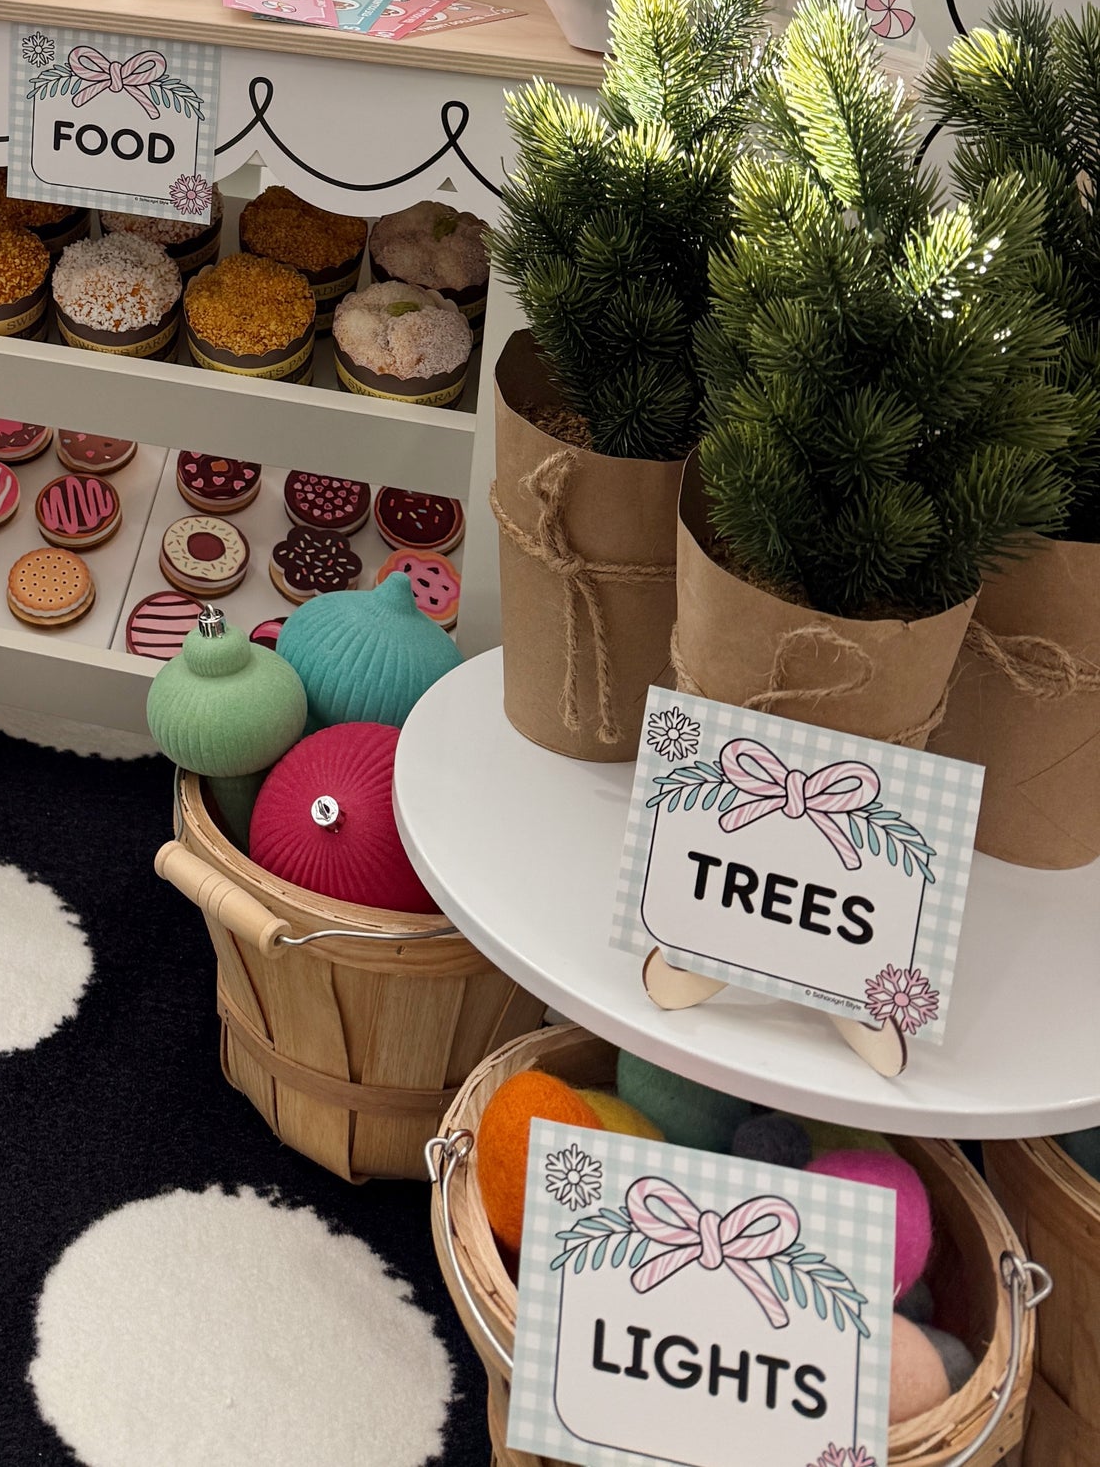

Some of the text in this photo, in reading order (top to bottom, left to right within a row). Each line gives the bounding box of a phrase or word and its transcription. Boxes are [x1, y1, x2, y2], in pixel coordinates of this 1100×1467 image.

[53, 120, 175, 164] FOOD
[687, 851, 875, 945] TREES
[592, 1318, 827, 1419] LIGHTS
